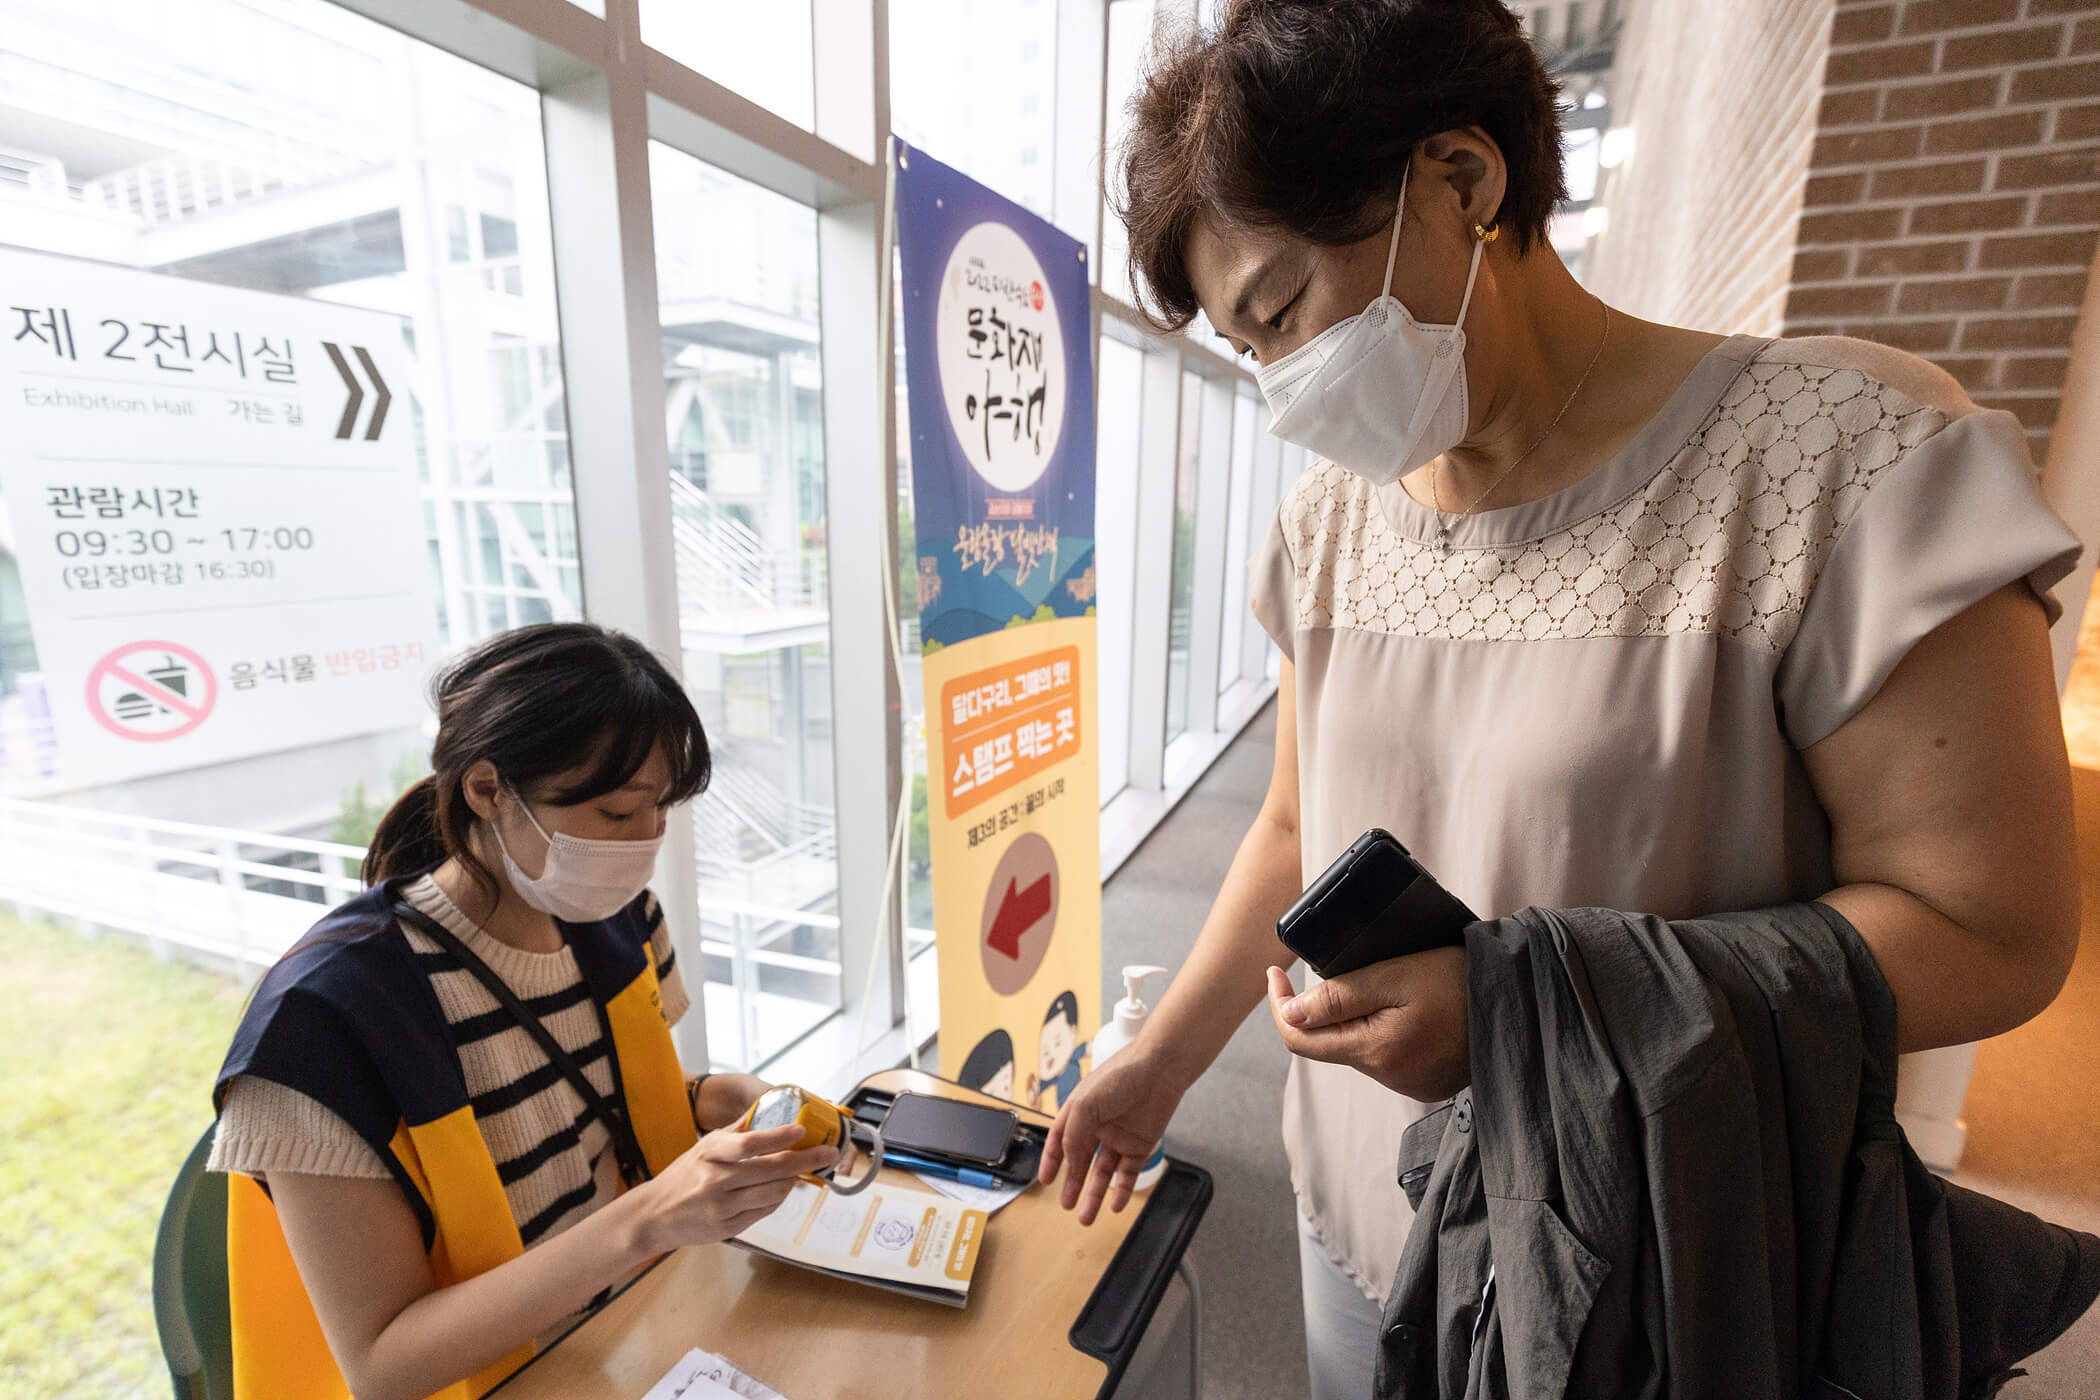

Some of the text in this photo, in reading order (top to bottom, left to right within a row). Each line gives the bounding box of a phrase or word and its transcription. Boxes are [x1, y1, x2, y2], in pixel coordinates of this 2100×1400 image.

[10, 306, 298, 385] 제 2전시실
[967, 306, 1043, 373] 문화재
[23, 386, 304, 427] Exhibition Hall 가는 길
[966, 368, 1046, 461] 야행
[46, 486, 200, 519] 관람시간
[54, 528, 174, 558] 09:30
[221, 526, 314, 553] 17:00
[62, 560, 276, 591] (입장마감 16:30)
[228, 642, 426, 690] 음식물 반입금지
[952, 707, 1075, 797] 스탬프 찍는 곳
